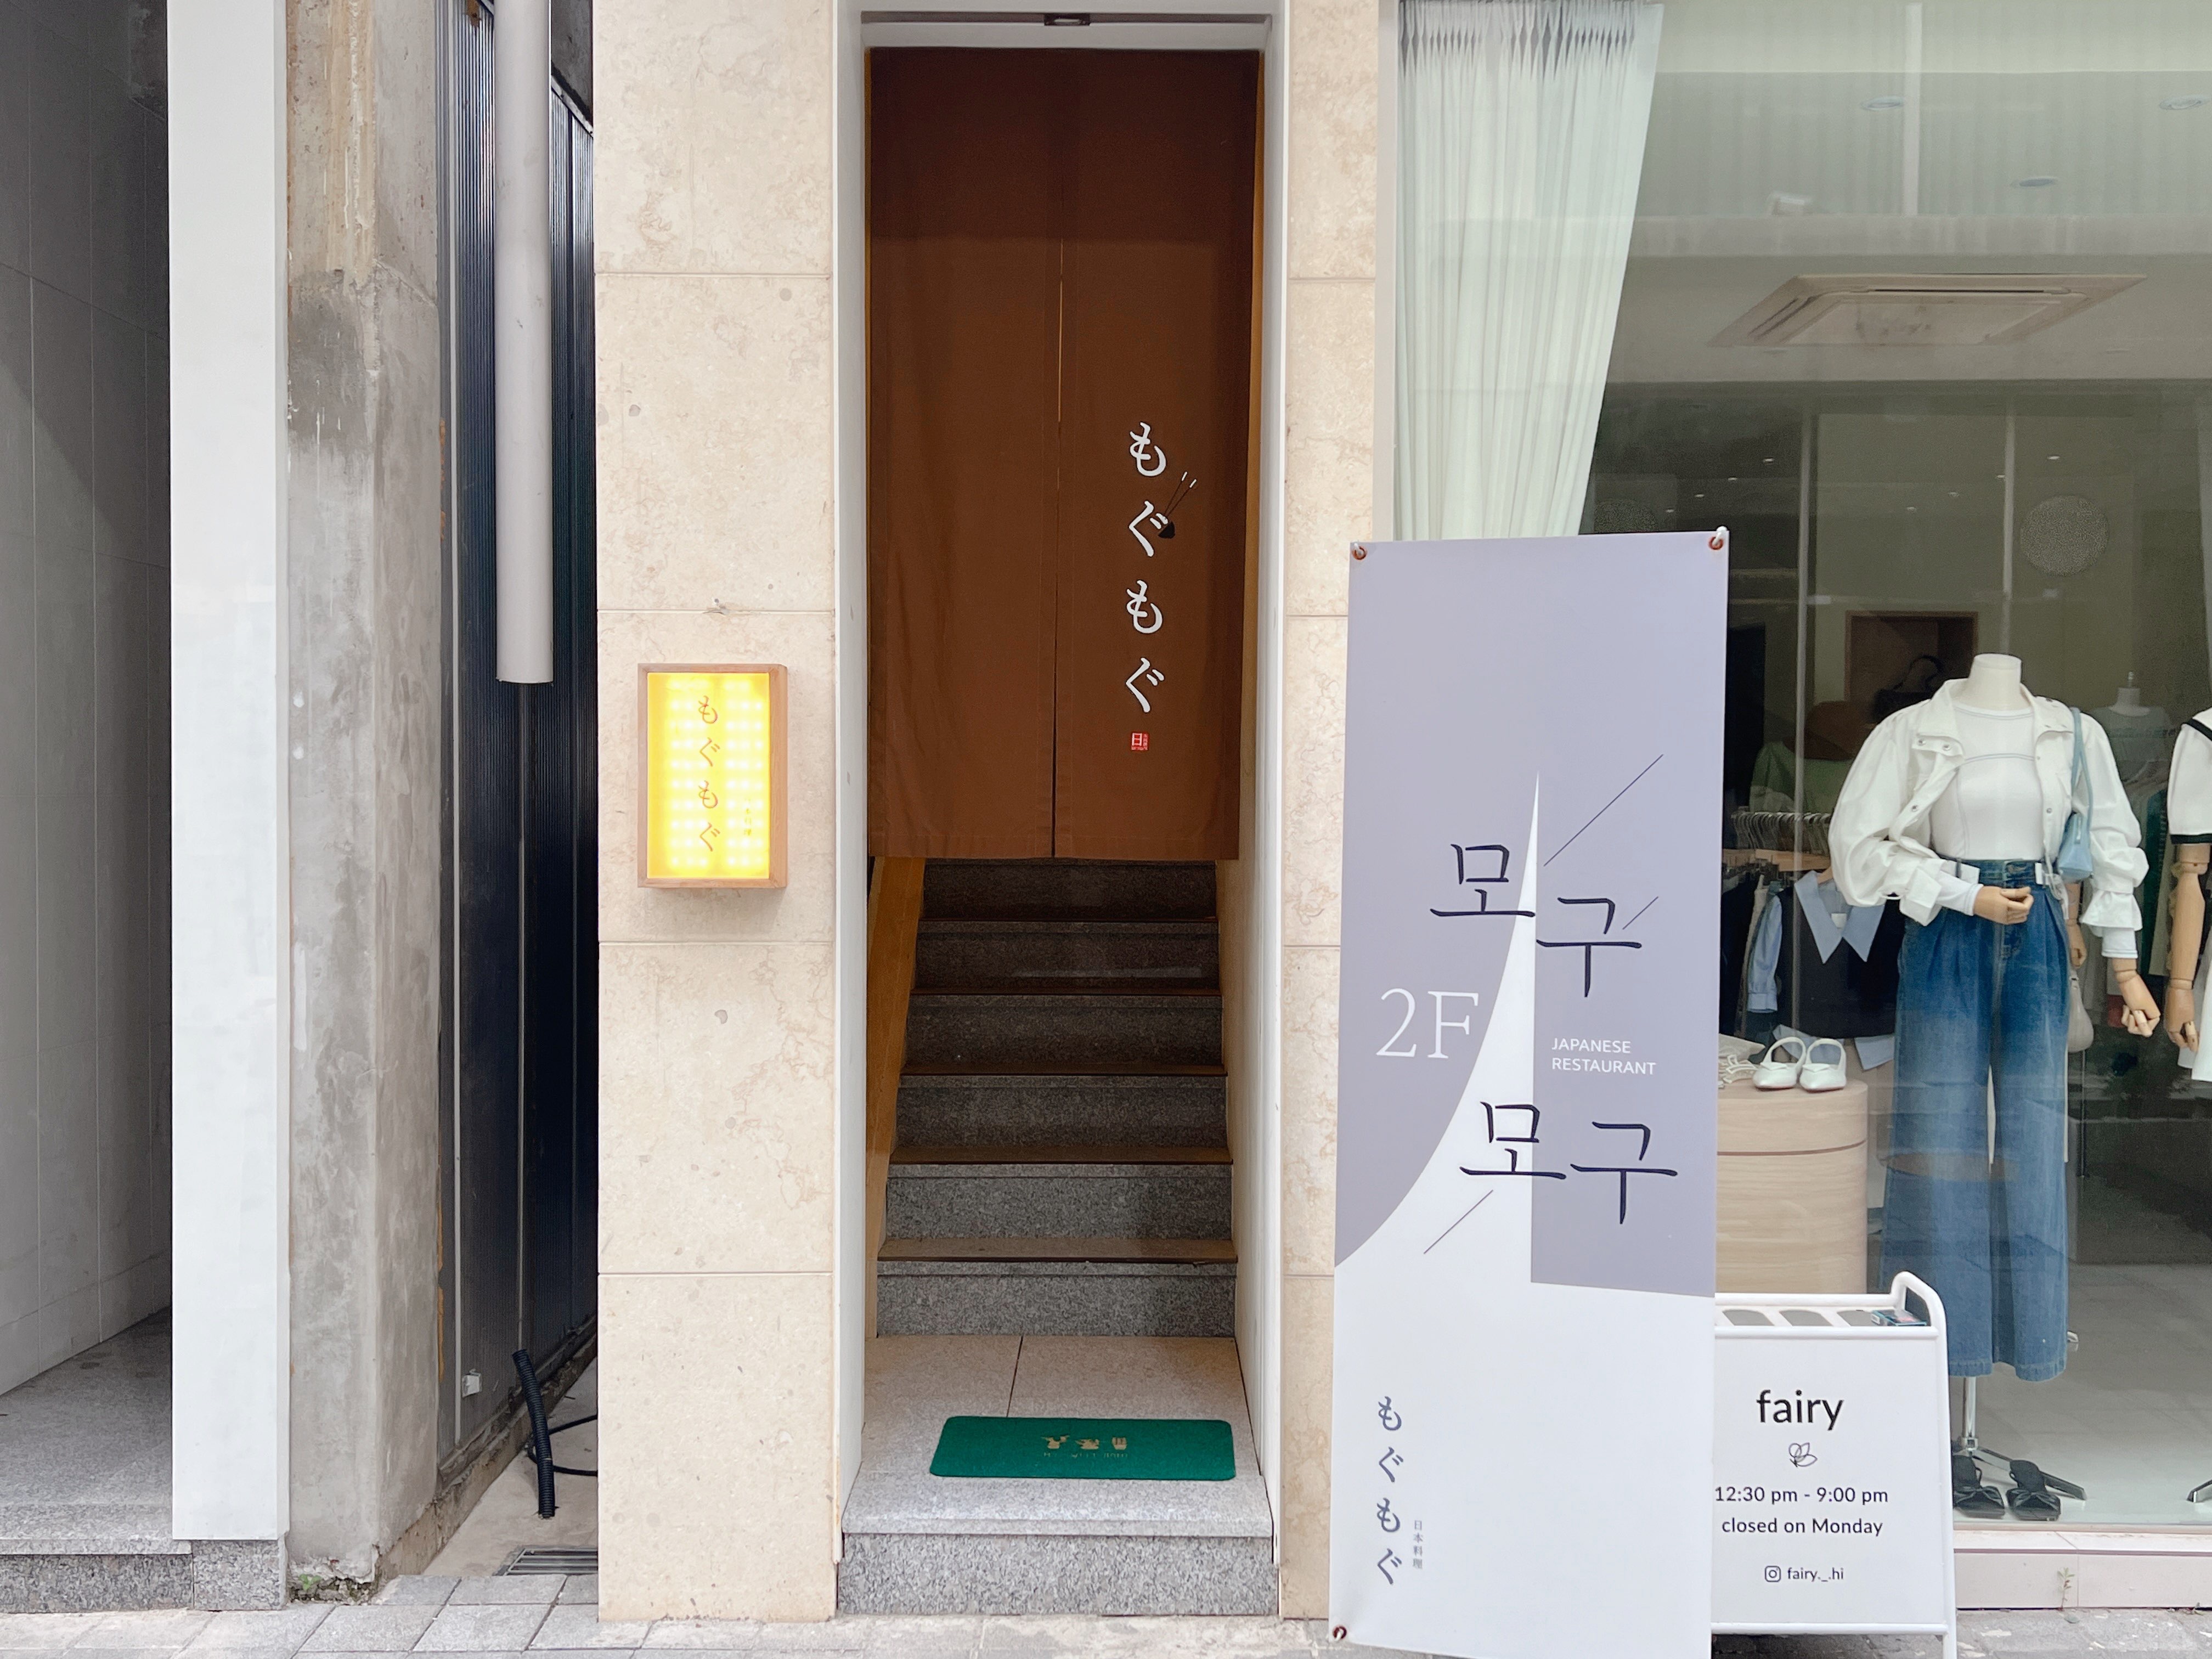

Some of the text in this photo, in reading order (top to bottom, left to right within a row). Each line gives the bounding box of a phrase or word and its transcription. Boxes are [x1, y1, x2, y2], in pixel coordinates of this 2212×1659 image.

[1125, 422, 1169, 713] もぐもぐ
[697, 695, 721, 852] もぐもぐ
[1376, 988, 1479, 1059] 2F
[1551, 1037, 1631, 1054] JAPANESE
[1551, 1057, 1657, 1075] RESTAURANT
[1756, 1389, 1844, 1431] fairy
[1376, 1396, 1404, 1585] もぐもぐ
[1714, 1486, 1765, 1502] 12:30
[1771, 1489, 1798, 1505] pm
[1816, 1487, 1856, 1503] 9:00
[1861, 1490, 1888, 1505] pm
[1722, 1517, 1883, 1537] closed on Monday
[1787, 1567, 1844, 1582] fairy._.hi
